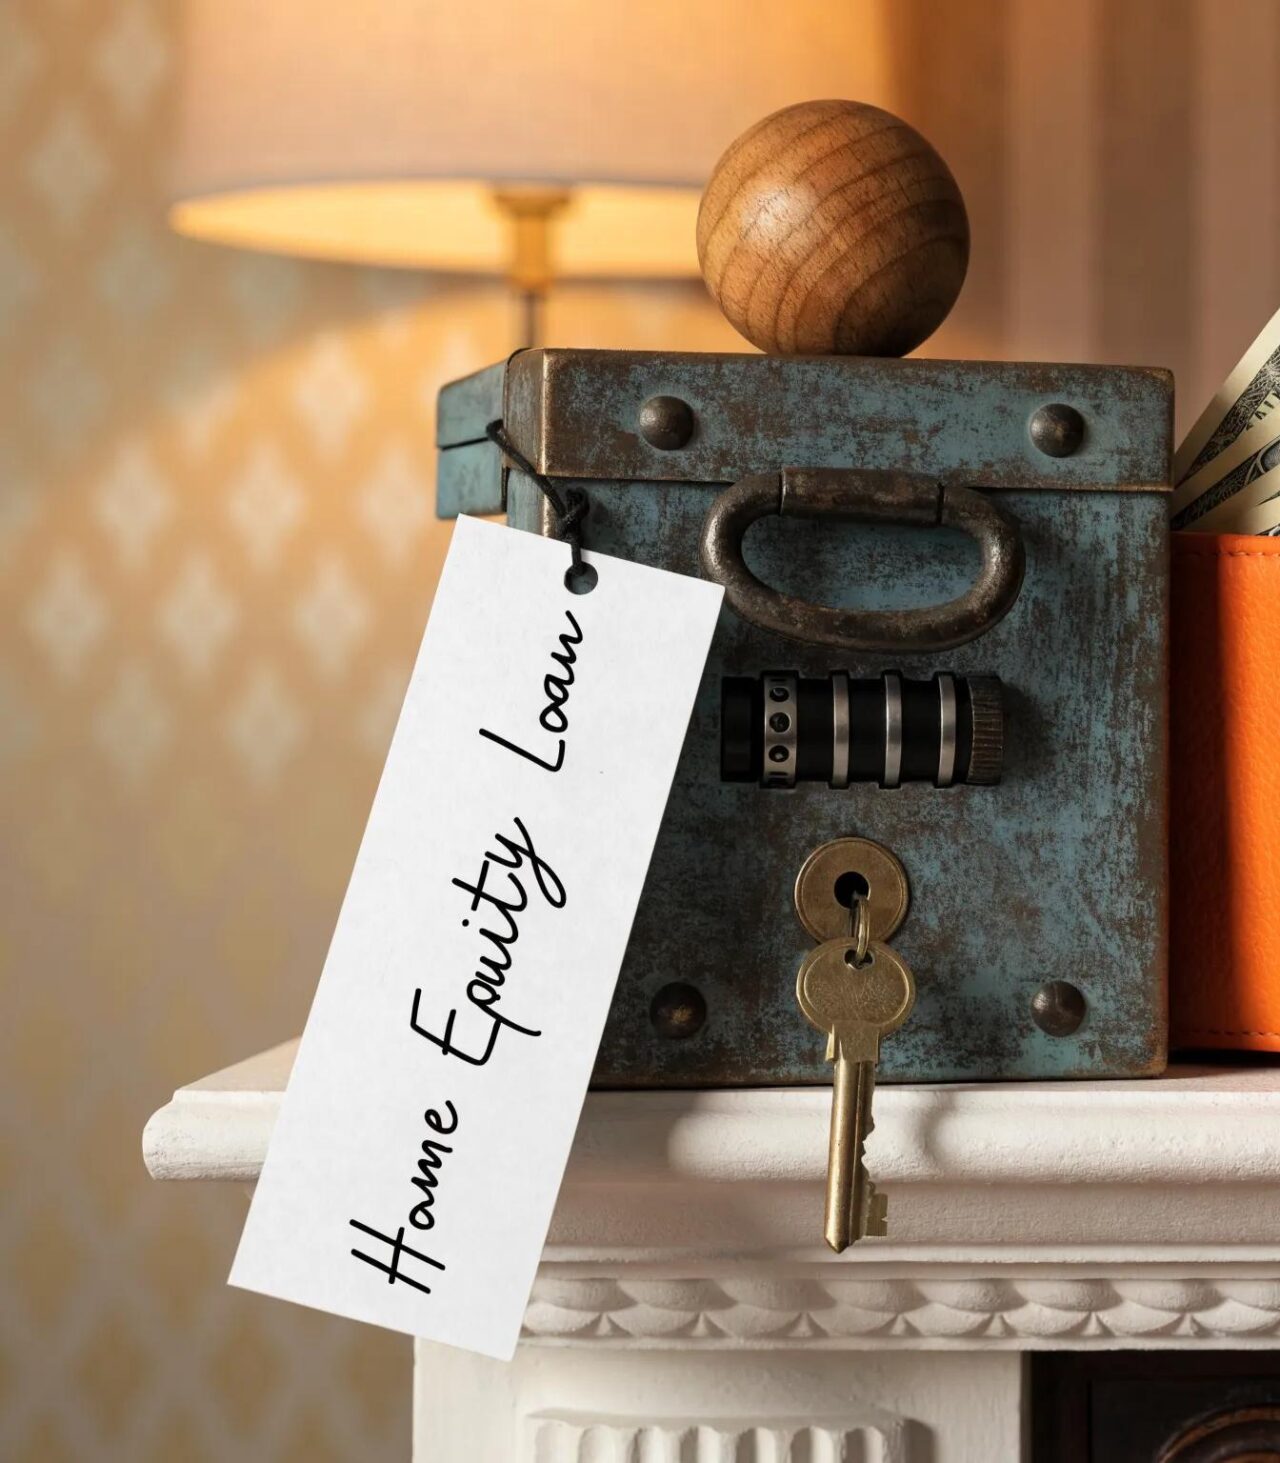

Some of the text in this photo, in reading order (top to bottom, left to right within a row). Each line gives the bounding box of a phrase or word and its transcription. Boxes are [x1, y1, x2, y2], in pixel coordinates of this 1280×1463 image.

[349, 609, 584, 1295] Home Equity Loan
